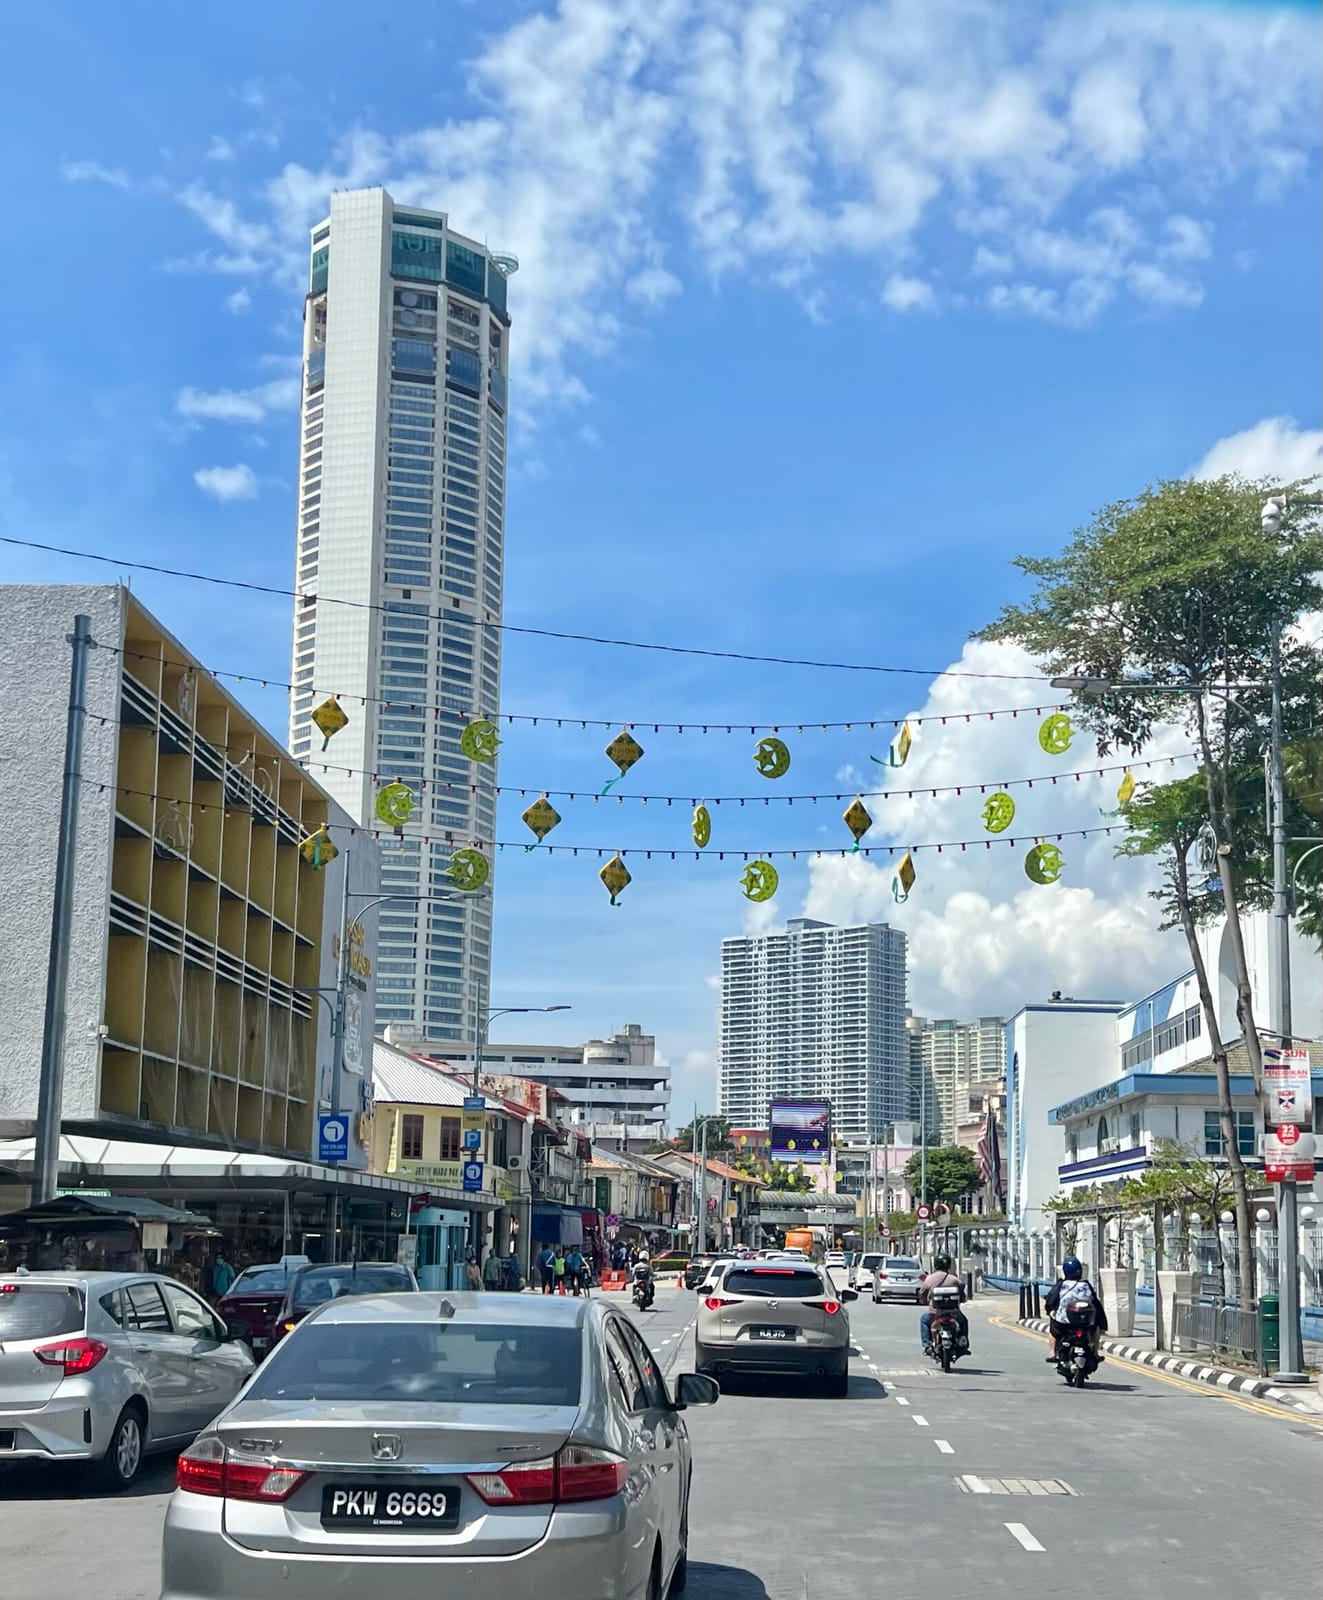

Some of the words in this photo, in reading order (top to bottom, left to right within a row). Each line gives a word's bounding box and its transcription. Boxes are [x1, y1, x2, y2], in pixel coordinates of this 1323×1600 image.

[433, 1167, 448, 1177] MADU
[332, 1490, 378, 1516] PKW
[386, 1491, 447, 1517] 6669
